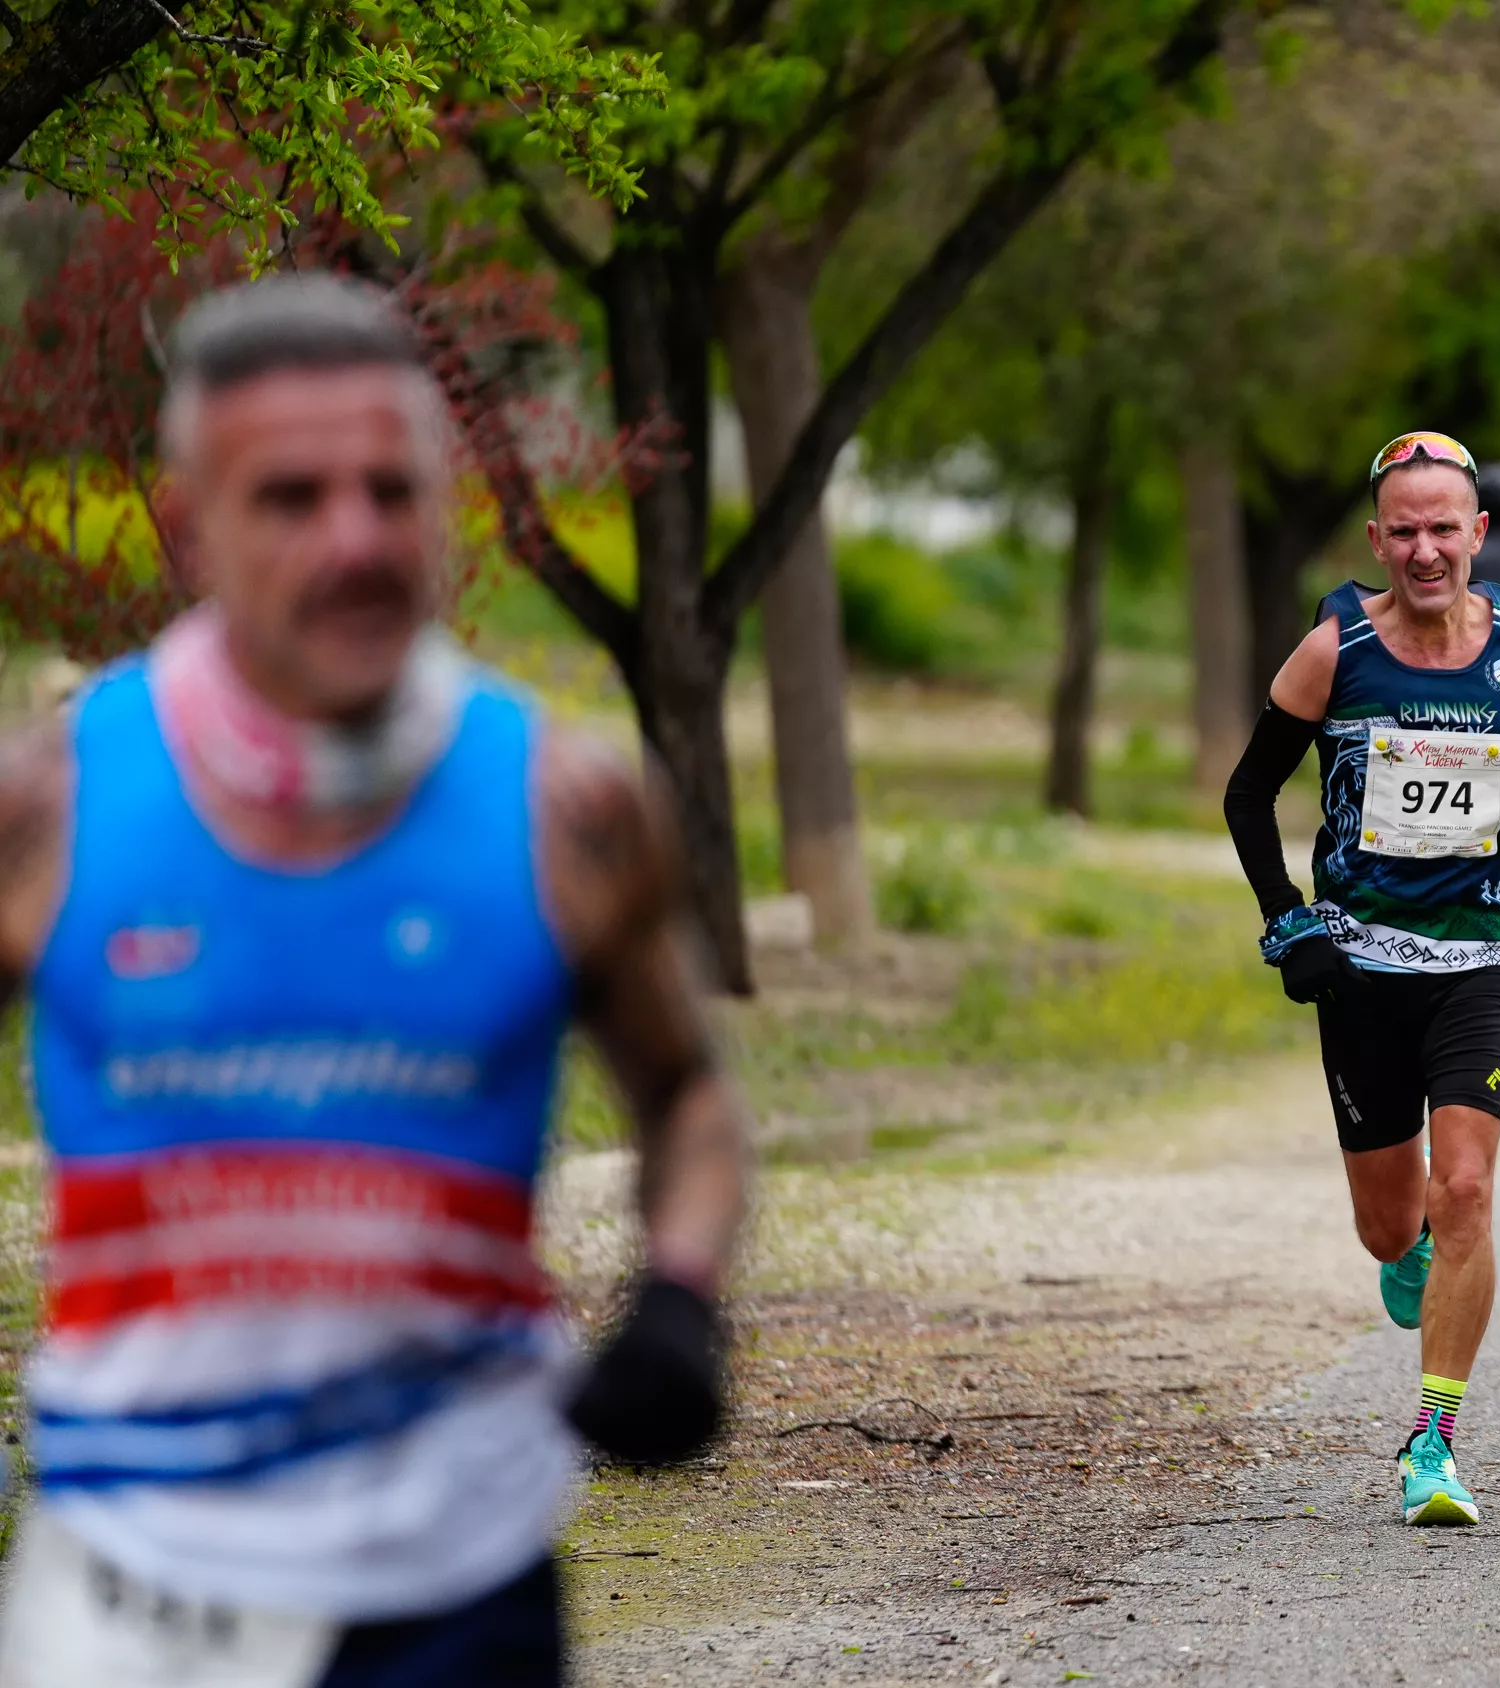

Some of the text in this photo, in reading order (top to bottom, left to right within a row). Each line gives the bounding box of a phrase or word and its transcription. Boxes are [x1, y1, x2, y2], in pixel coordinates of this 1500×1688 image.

[1401, 701, 1498, 724] RUNNING
[1425, 756, 1468, 769] LUCENA
[1401, 780, 1474, 815] 974
